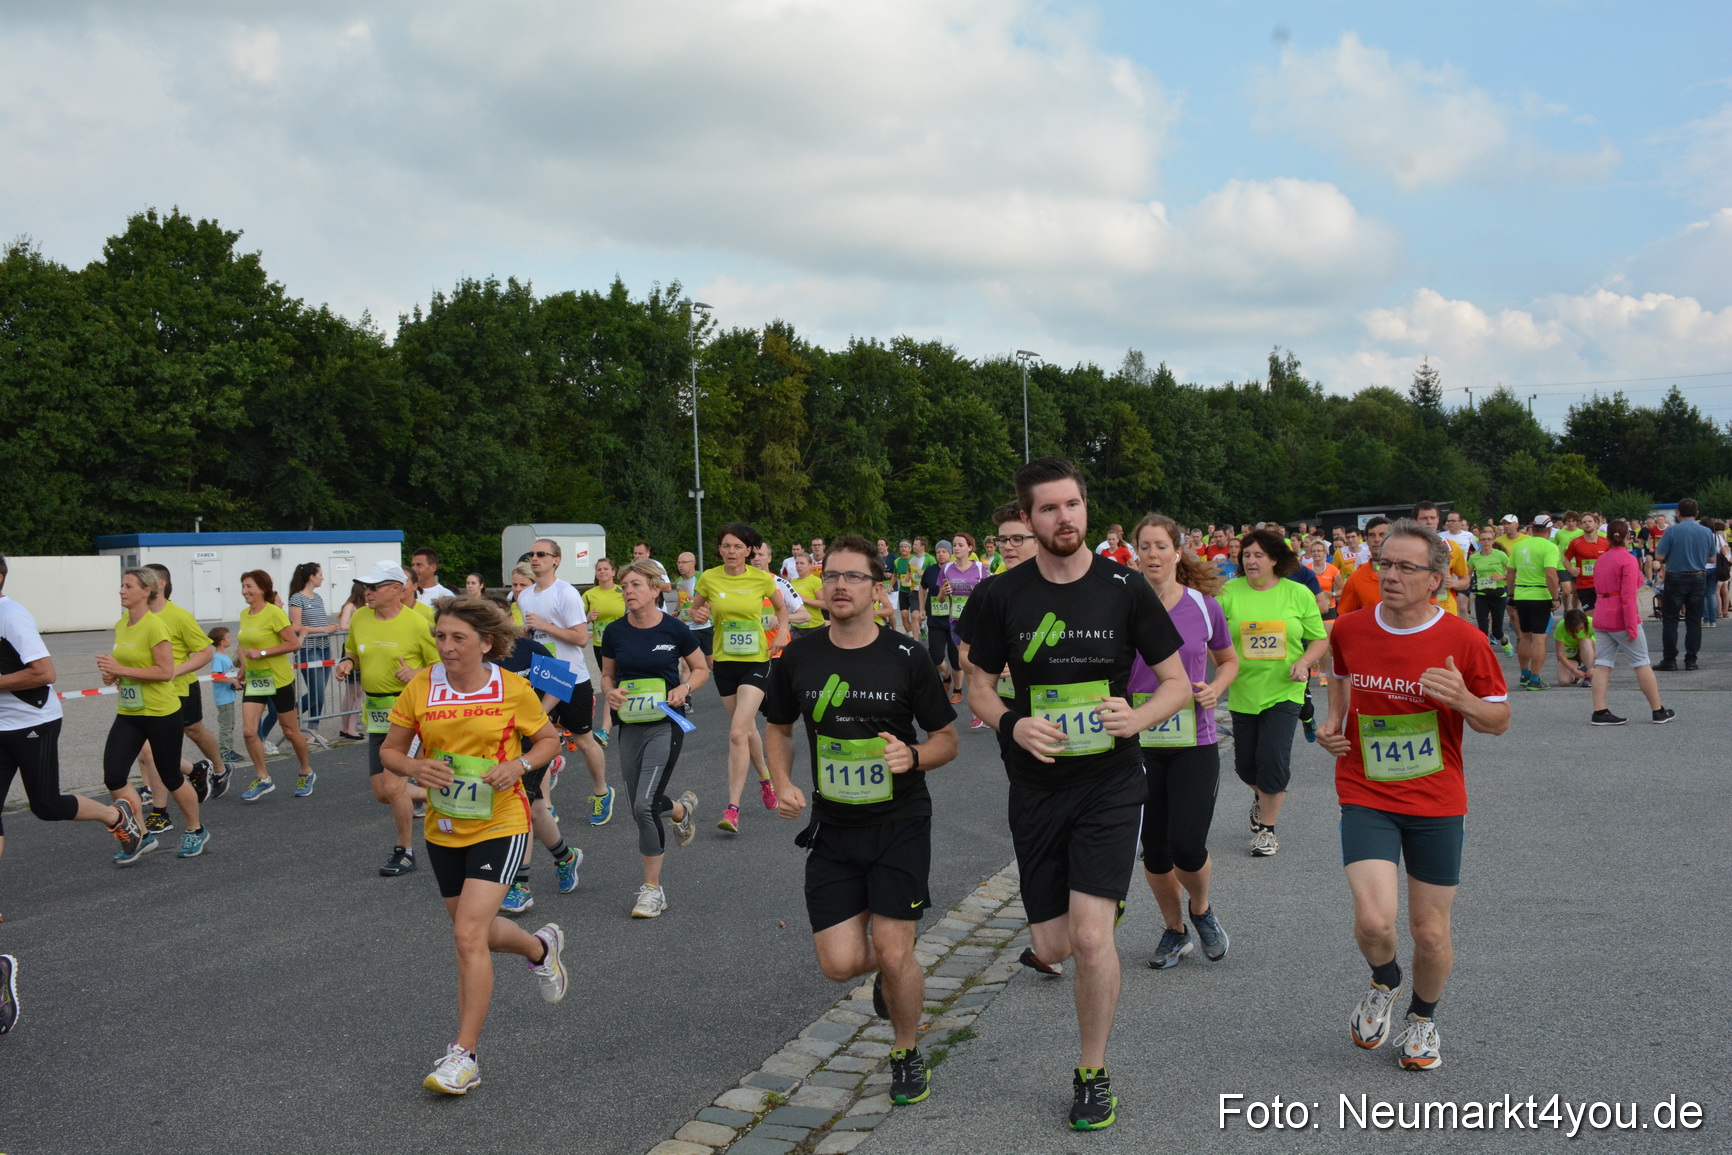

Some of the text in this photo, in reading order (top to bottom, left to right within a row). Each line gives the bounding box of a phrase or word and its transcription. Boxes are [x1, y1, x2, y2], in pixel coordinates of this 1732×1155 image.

[729, 634, 753, 645] 595
[1250, 636, 1277, 649] 232
[251, 679, 270, 688] 635
[627, 696, 655, 711] 771
[425, 709, 458, 721] MAX
[463, 705, 503, 717] BÖGL
[1370, 737, 1434, 763] 1414
[825, 763, 885, 786] 1118
